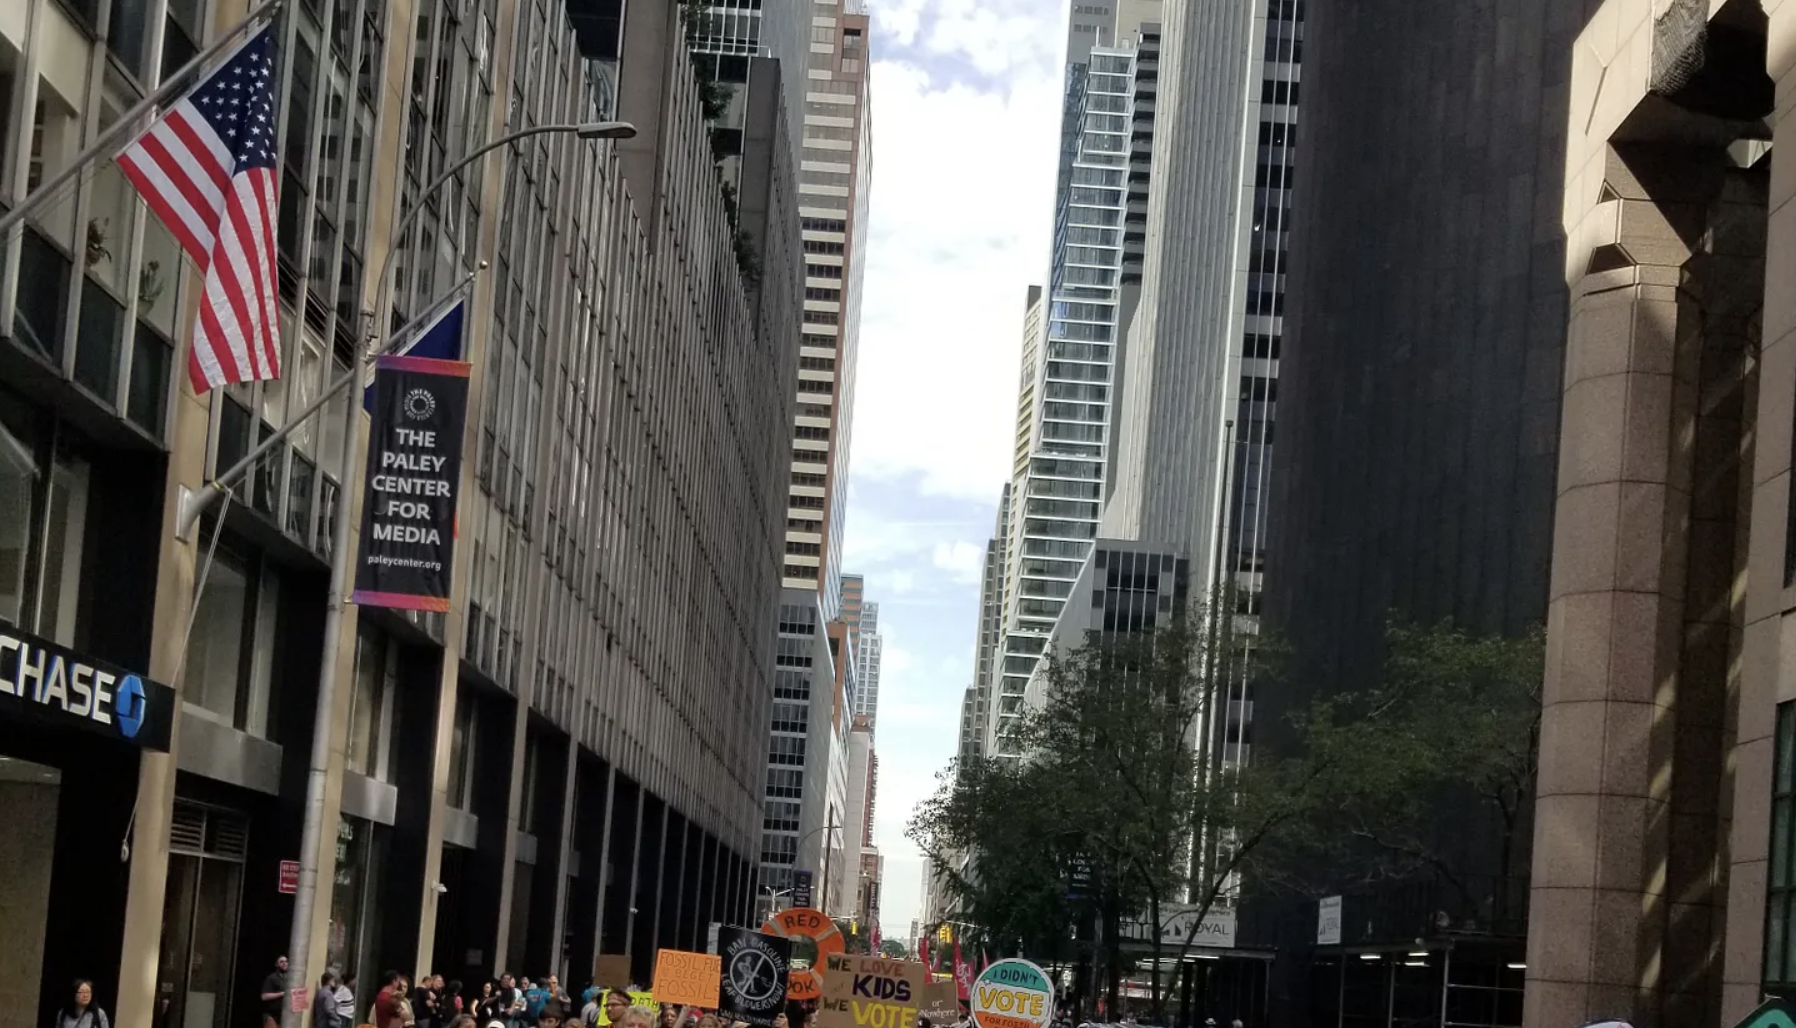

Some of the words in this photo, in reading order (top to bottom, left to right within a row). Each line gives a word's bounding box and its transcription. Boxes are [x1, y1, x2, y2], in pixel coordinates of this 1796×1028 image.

[396, 428, 436, 448] THE
[383, 452, 446, 472] PALEY
[371, 475, 451, 497] CENTER
[387, 502, 431, 520] FOR
[373, 523, 441, 545] MEDIA
[368, 554, 442, 571] paleycenter.org
[0, 635, 115, 725] CHASE
[784, 913, 820, 928] RED
[1184, 921, 1229, 935] ROYAL
[727, 938, 747, 956] BAN
[660, 951, 701, 970] FOSSIL
[827, 957, 851, 971] WE
[860, 961, 905, 977] LOVE
[1000, 968, 1038, 985] DIDN'T
[852, 974, 911, 1002] KIDS
[823, 997, 848, 1011] WE
[979, 986, 1044, 1016] VOTE
[984, 1016, 1001, 1025] FOR
